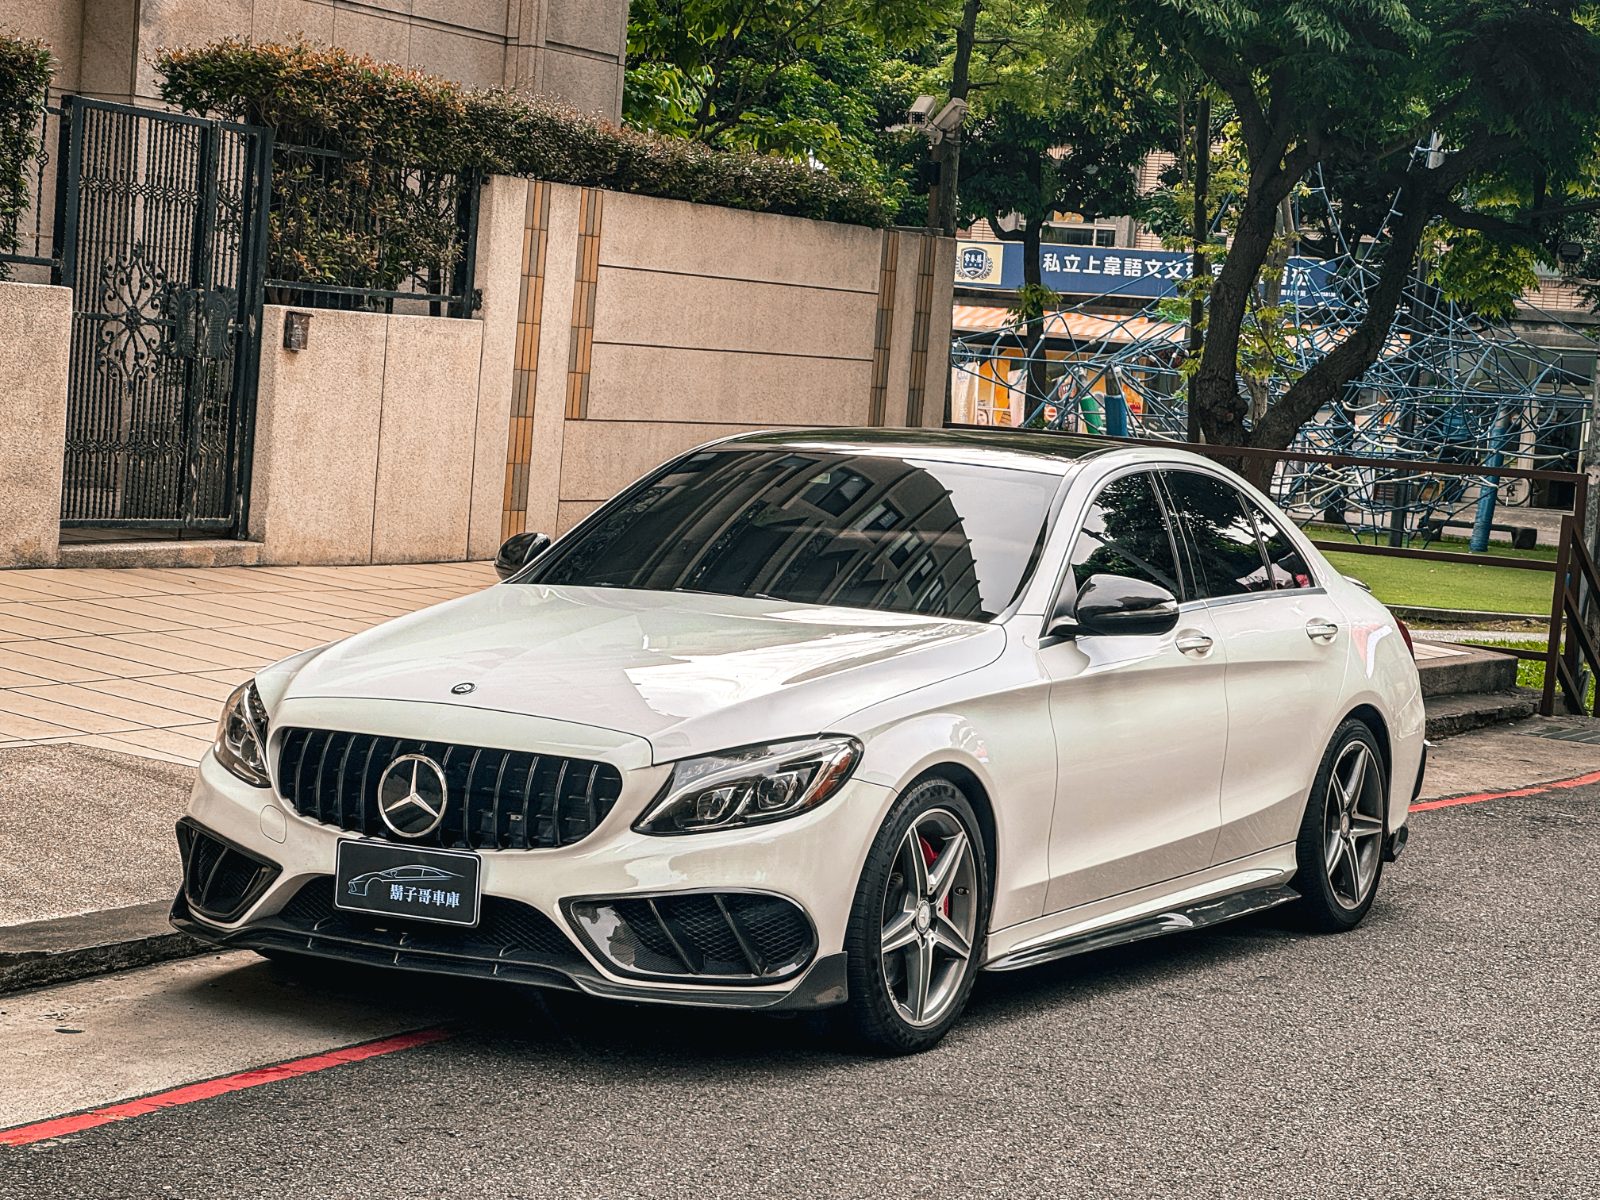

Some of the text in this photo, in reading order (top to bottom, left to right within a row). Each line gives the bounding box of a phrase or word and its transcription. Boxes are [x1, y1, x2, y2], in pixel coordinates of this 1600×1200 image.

[1042, 253, 1310, 287] 私立上韋語文文班
[390, 883, 460, 908] 鬍子哥車庫
